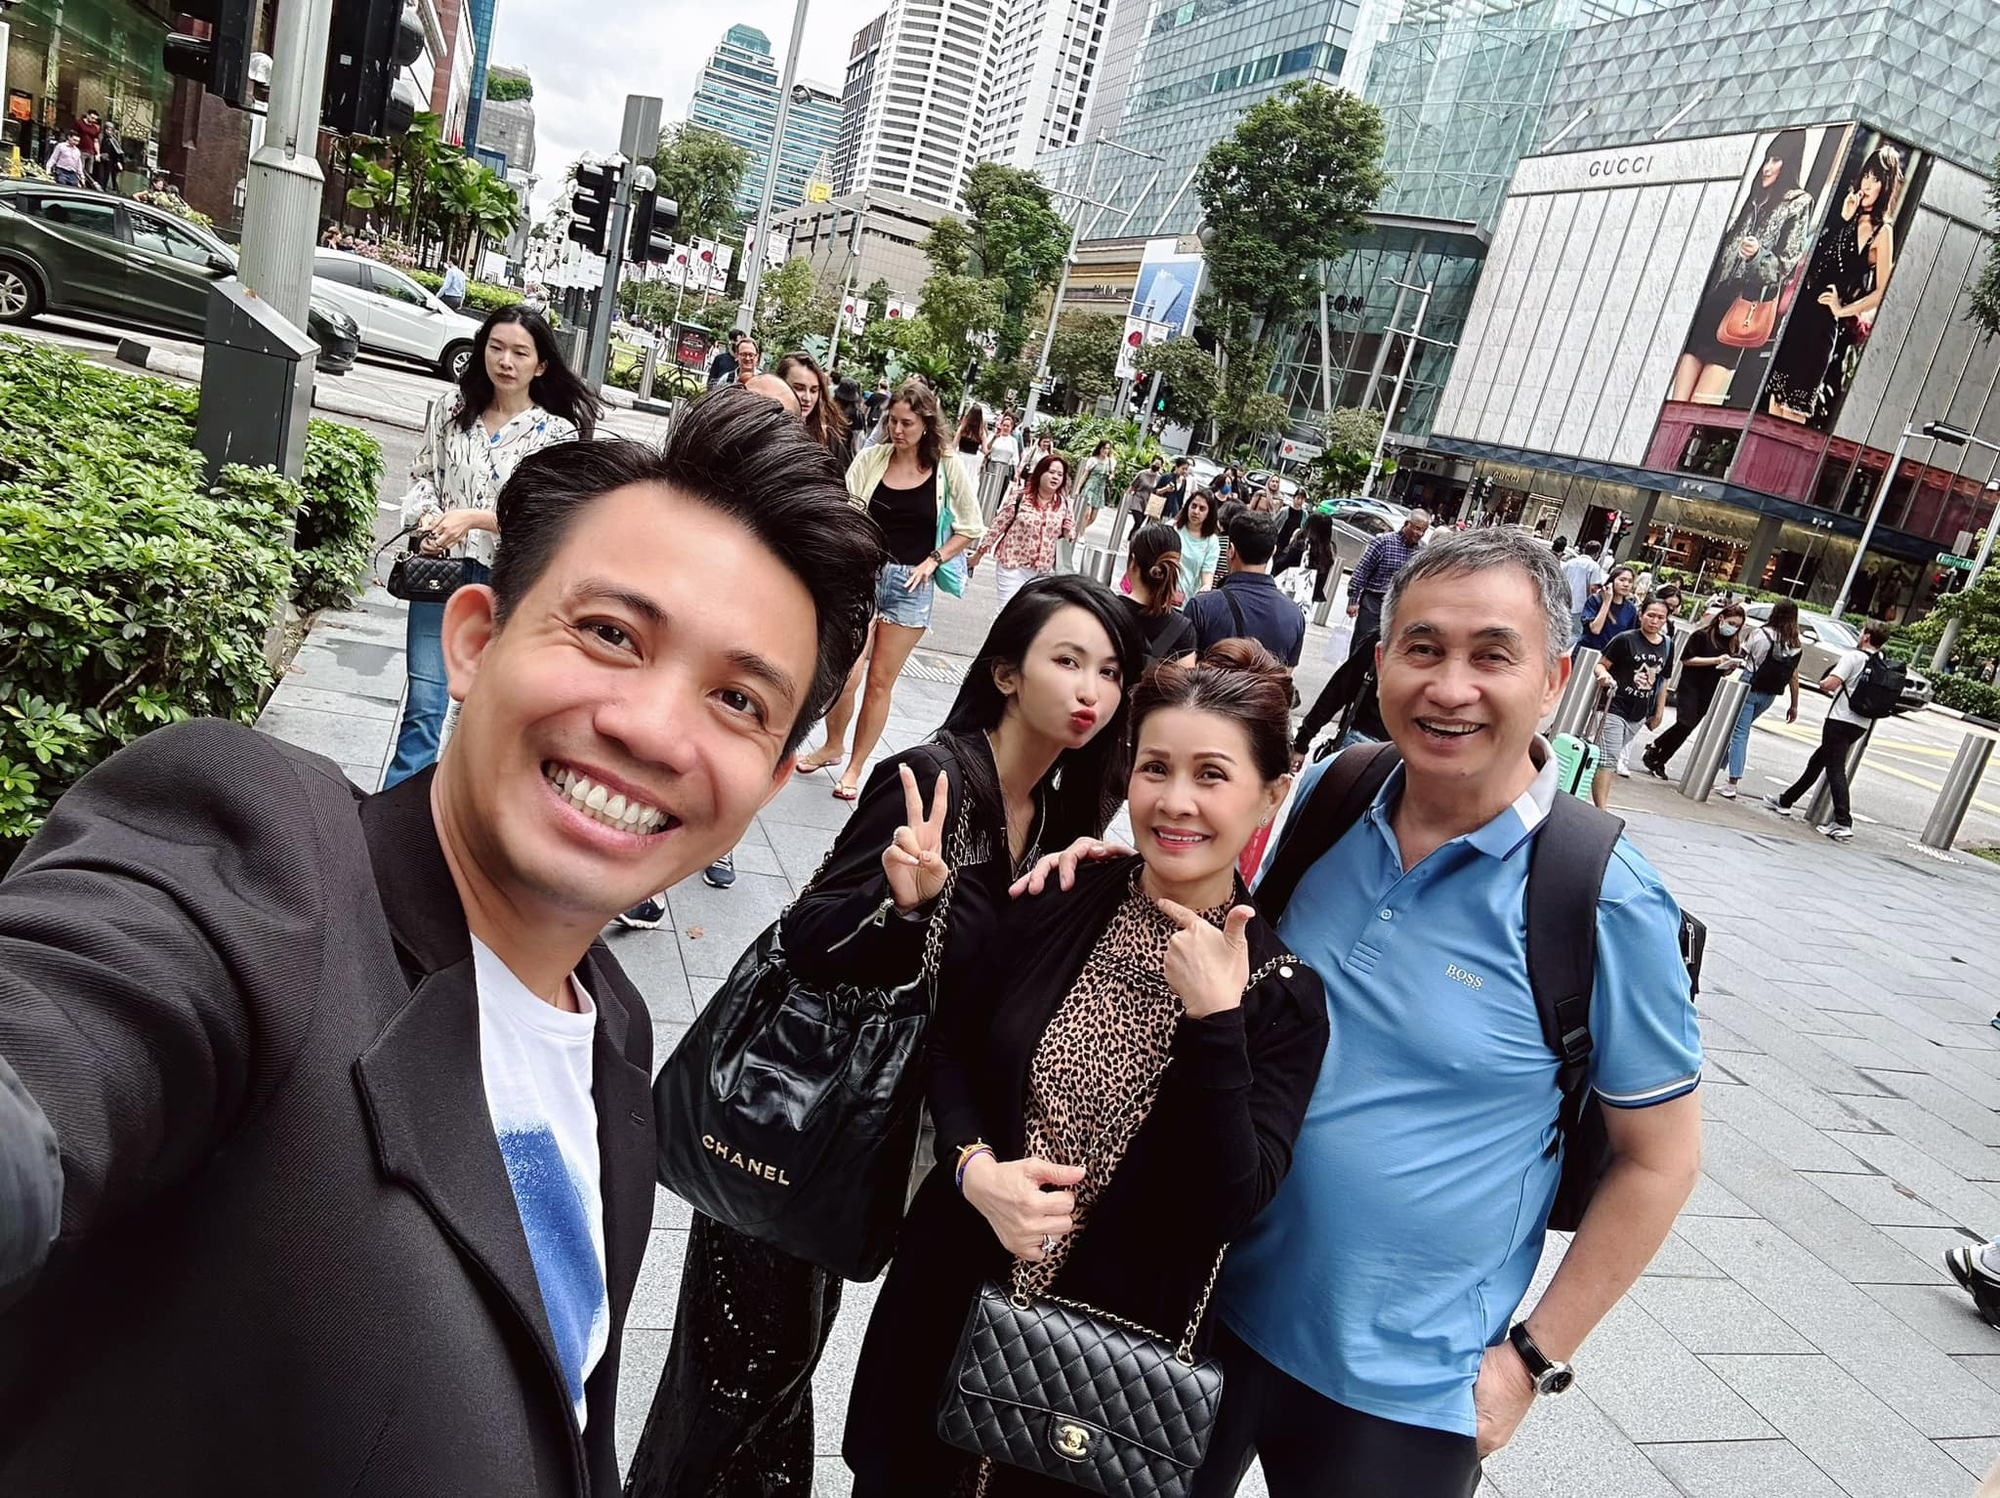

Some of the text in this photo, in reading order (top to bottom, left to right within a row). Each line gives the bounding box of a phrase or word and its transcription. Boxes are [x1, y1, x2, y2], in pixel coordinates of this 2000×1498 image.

[1589, 156, 1654, 177] GUCCI
[1493, 469, 1520, 484] GUCCI
[1446, 963, 1484, 988] BOSS
[701, 1134, 790, 1187] CHANEL
